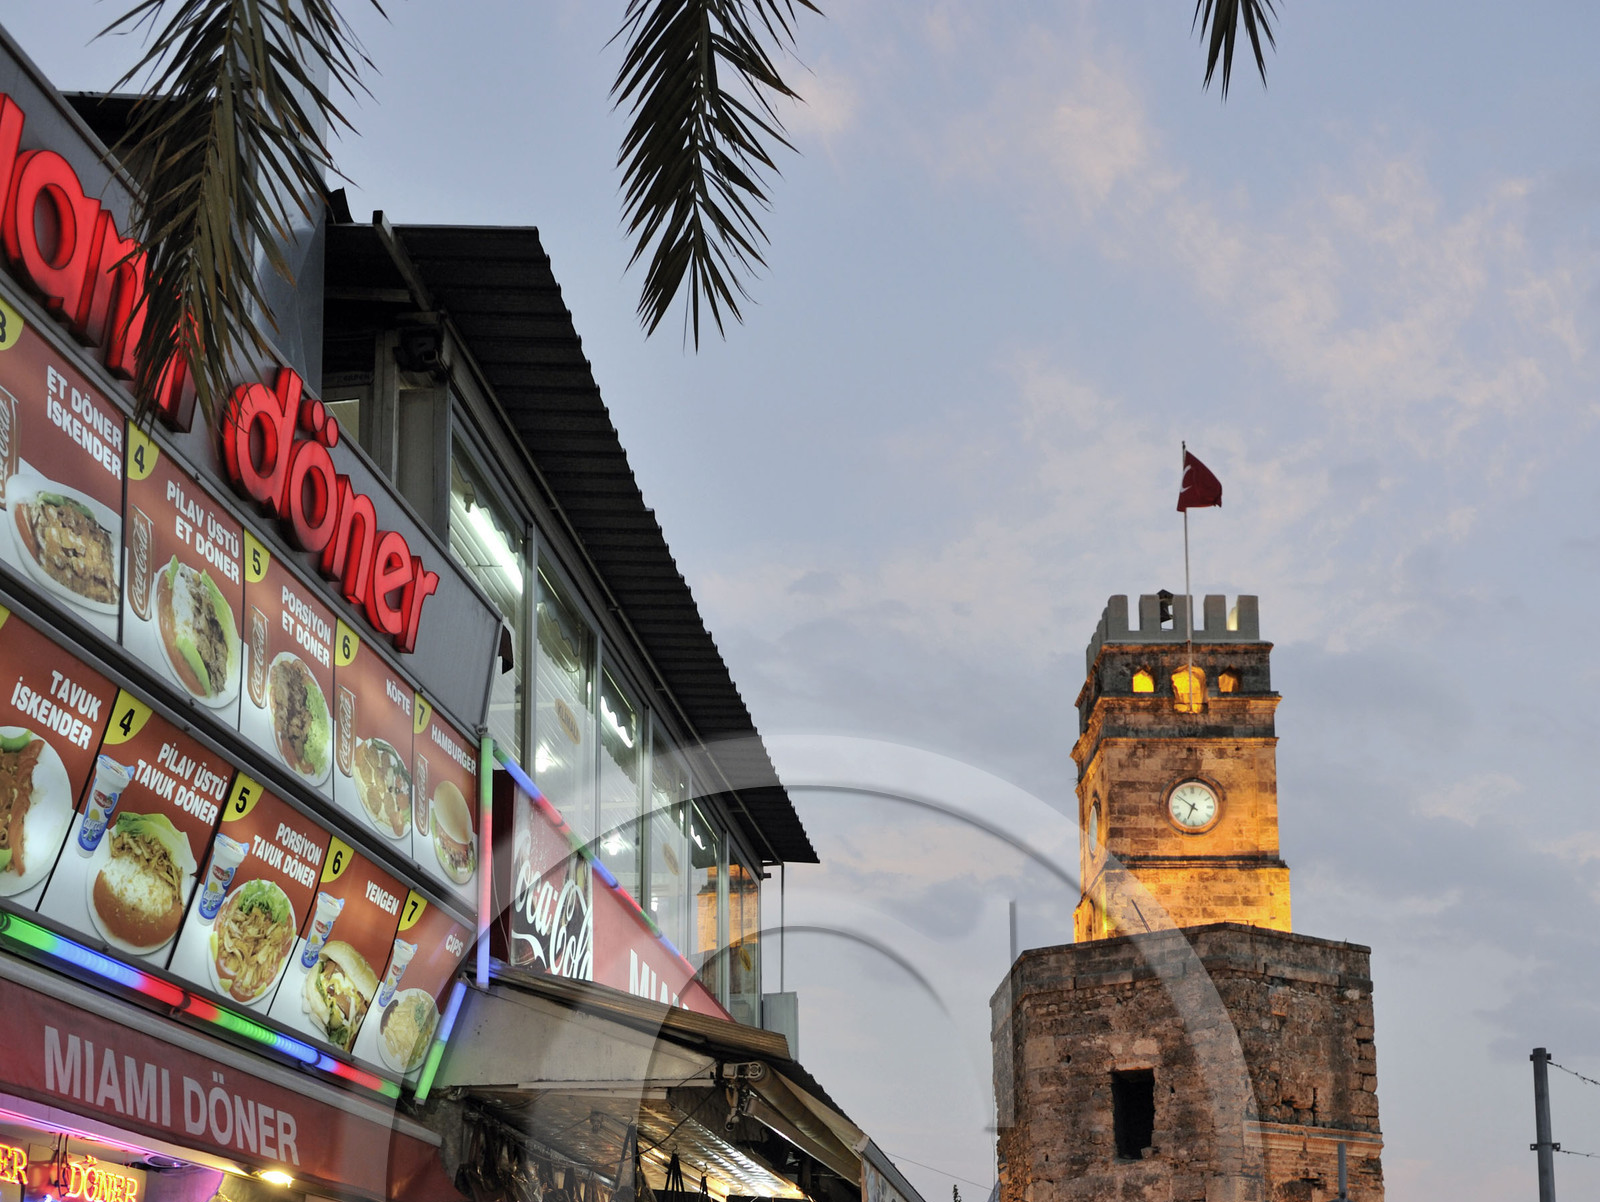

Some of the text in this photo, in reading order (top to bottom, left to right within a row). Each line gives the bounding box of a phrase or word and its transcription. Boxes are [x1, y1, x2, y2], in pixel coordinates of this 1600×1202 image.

[47, 365, 68, 399] ET
[71, 387, 122, 452] DÖNER
[47, 389, 122, 480] İSKENDER
[134, 445, 145, 473] 4
[166, 480, 239, 559] PİLAV ÜSTÜ
[222, 367, 440, 654] döner
[176, 515, 240, 585] ET DÖNER
[252, 548, 261, 576] 5
[281, 585, 331, 646] PORSİYON
[282, 610, 330, 669] ET DÖNER
[342, 635, 351, 660] 6
[10, 676, 93, 750] İSKENDER
[50, 669, 102, 723] TAVUK
[119, 708, 136, 737] 4
[386, 678, 411, 717] KÖFTE
[418, 703, 425, 726] 7
[157, 742, 228, 801] PİLAV ÜSTÜ
[431, 724, 476, 776] HAMBURGER
[134, 758, 177, 801] TAVUK
[173, 785, 219, 827] DÖNER
[235, 787, 250, 813] 5
[251, 834, 316, 889] TAVUK DÖNER
[275, 822, 323, 866] PORSİYON
[332, 850, 343, 875] 6
[365, 880, 400, 916] YENGEN
[407, 900, 418, 922] 7
[44, 1025, 300, 1166] MIAMI DÖNER
